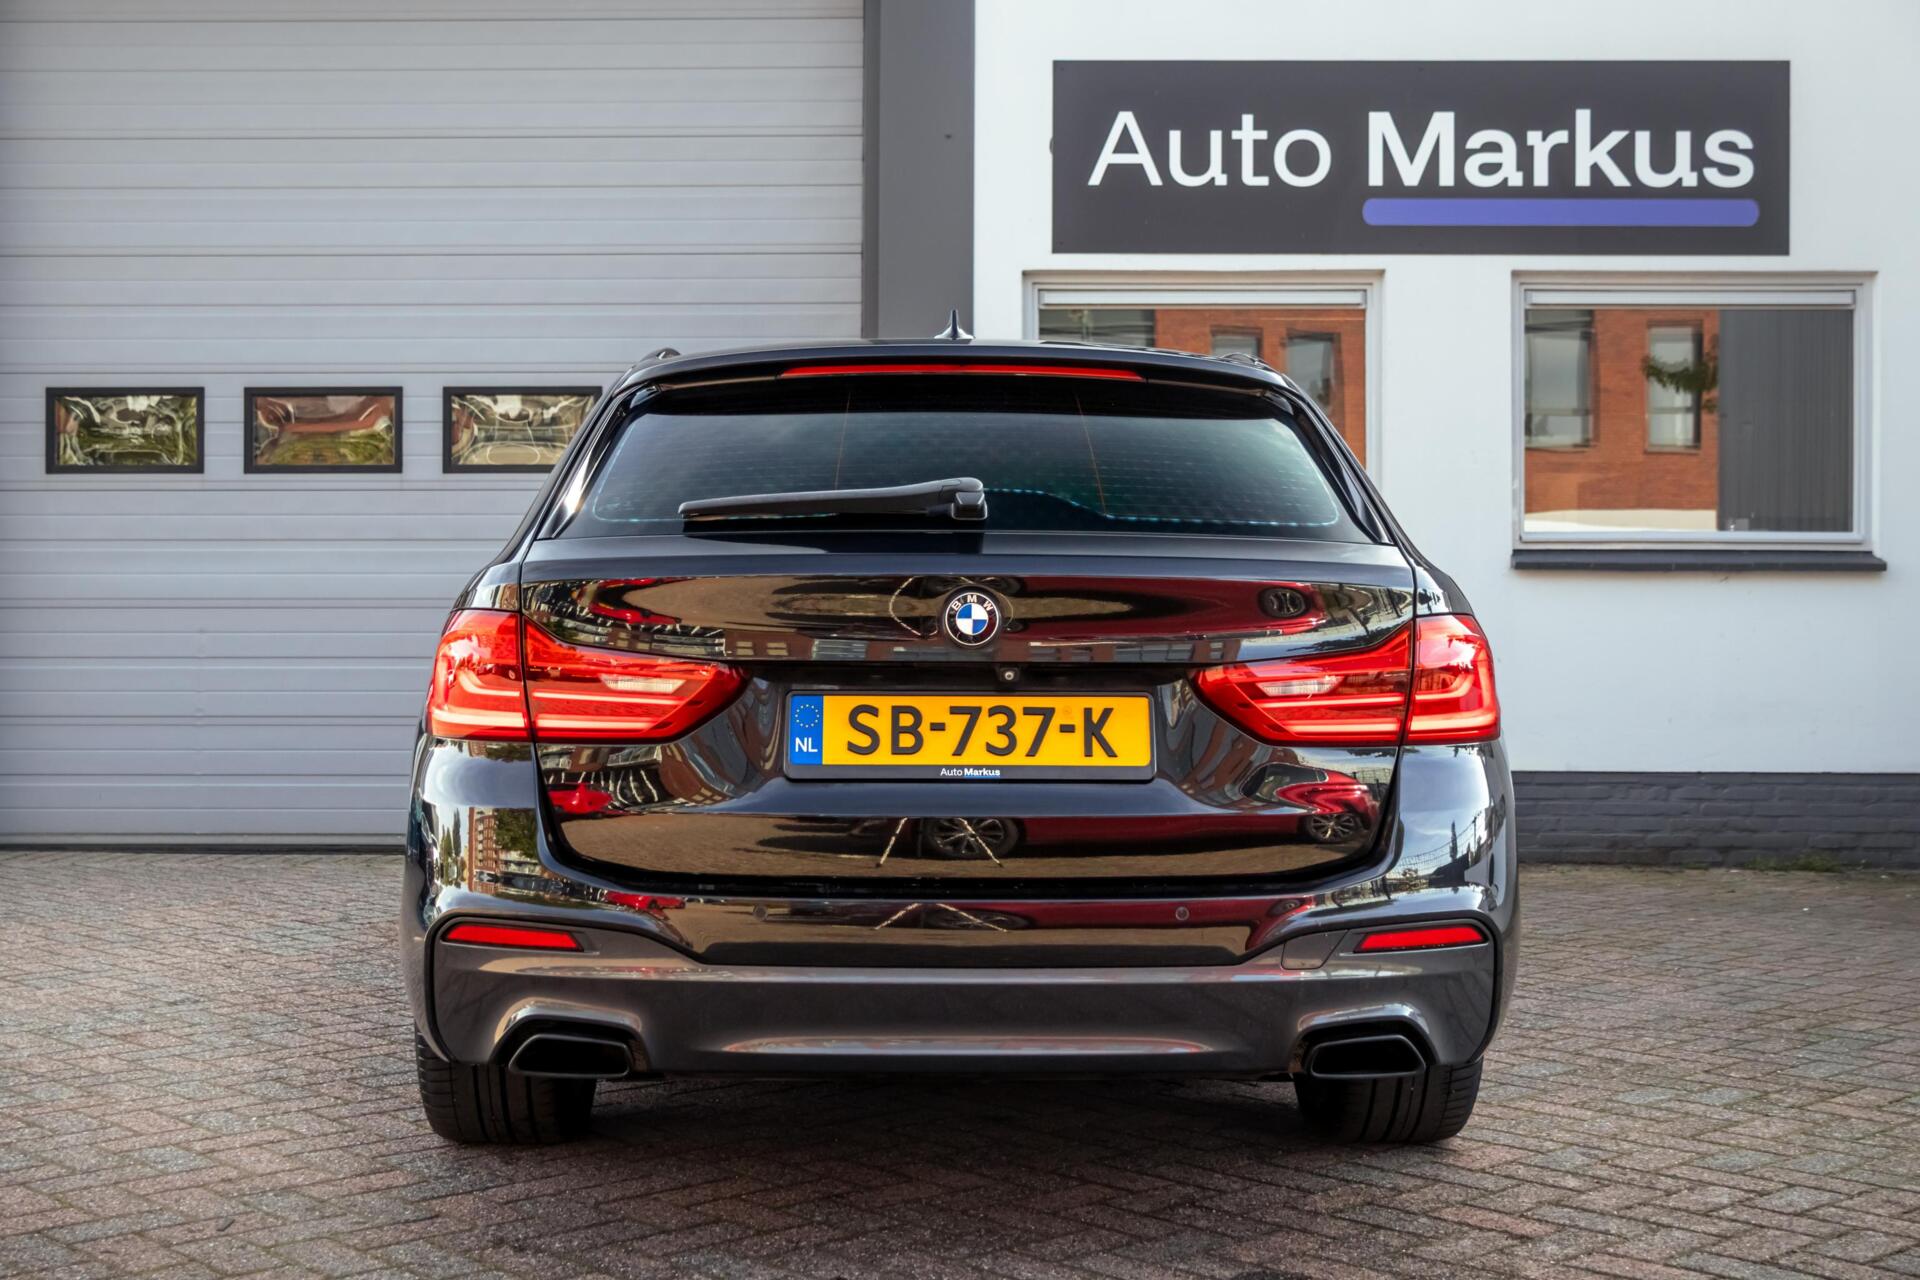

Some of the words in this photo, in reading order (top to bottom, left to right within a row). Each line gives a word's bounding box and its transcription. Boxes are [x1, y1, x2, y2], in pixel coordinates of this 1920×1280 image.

[1087, 110, 1332, 187] Auto
[1367, 108, 1755, 188] Markus
[951, 594, 994, 612] BMW
[847, 704, 1118, 758] SB-737-K
[795, 737, 818, 753] NL
[940, 767, 963, 777] Auto
[963, 767, 1001, 777] Markus
